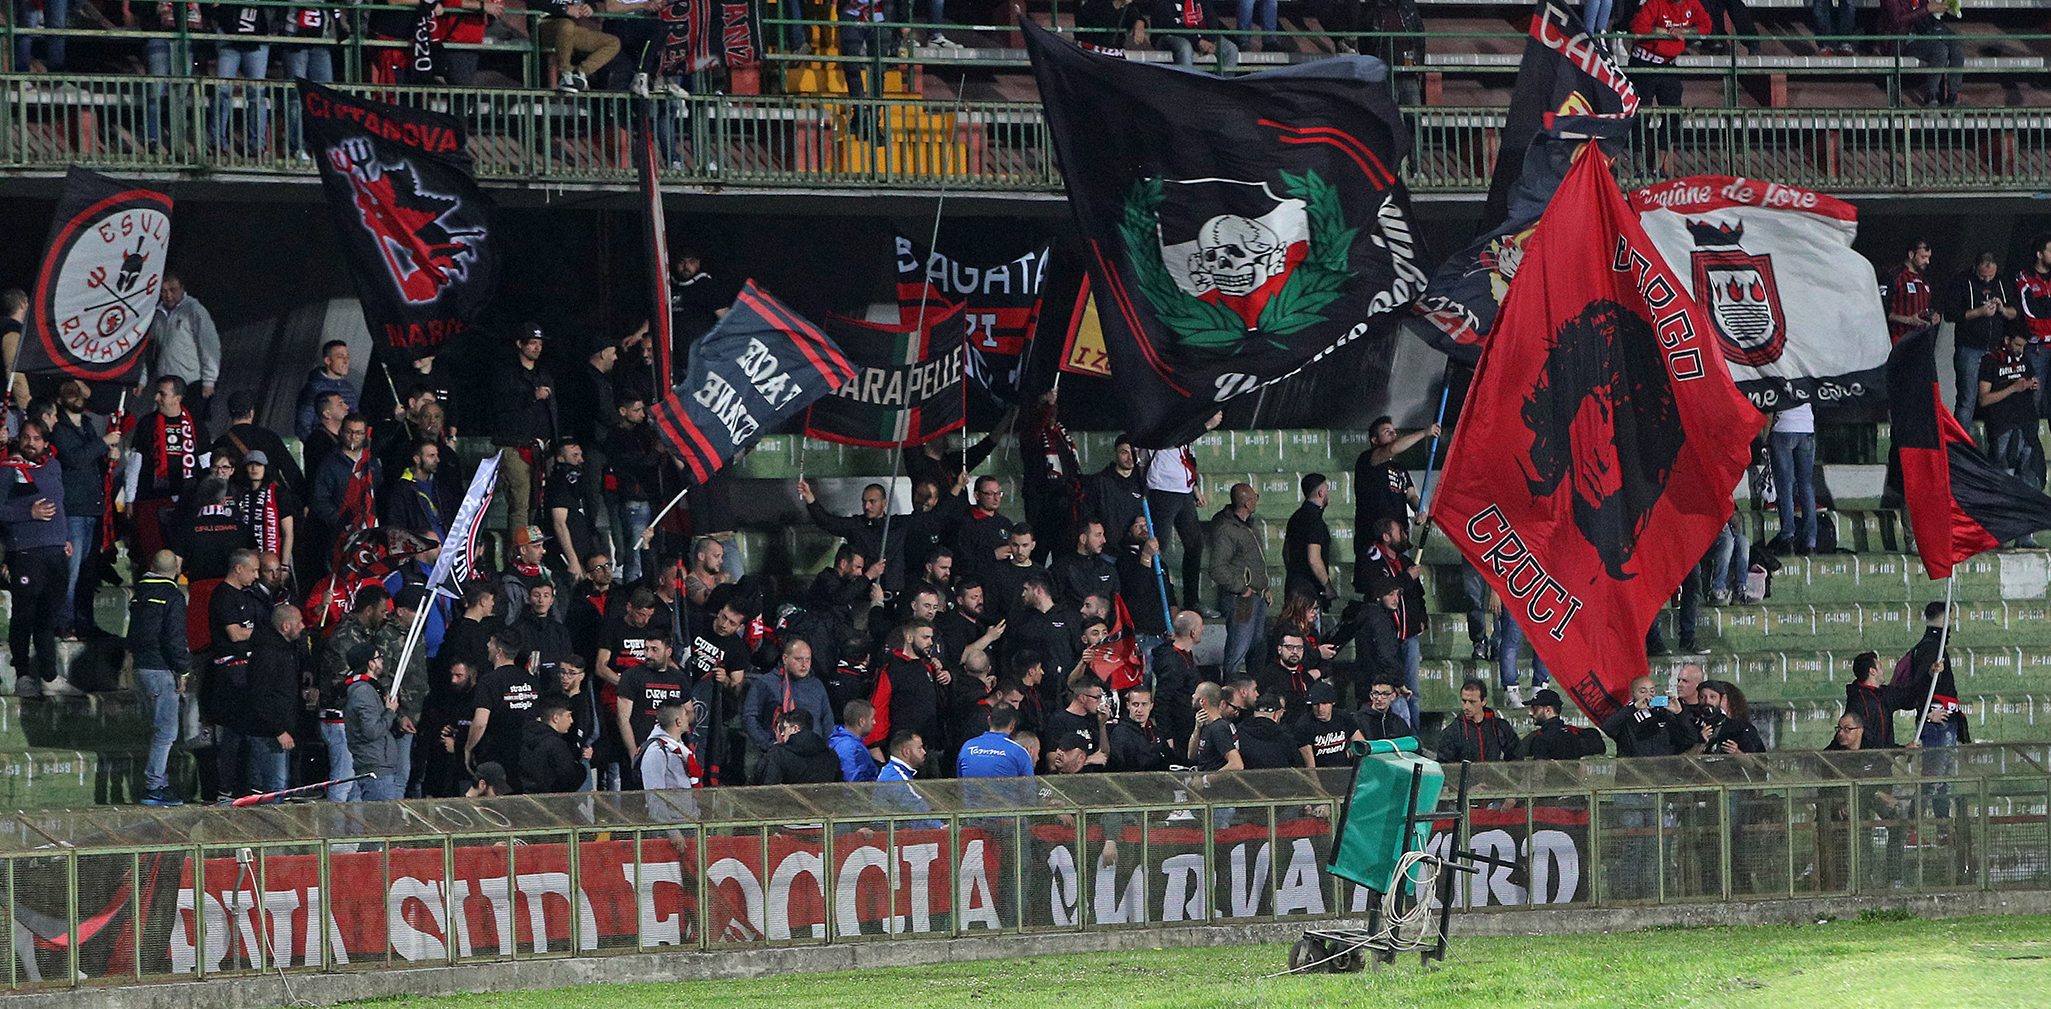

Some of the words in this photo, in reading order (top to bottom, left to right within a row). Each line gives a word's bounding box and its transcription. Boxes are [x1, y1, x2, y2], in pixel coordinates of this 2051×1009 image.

[1632, 47, 1665, 64] SUD
[61, 312, 143, 359] ROMANI
[829, 345, 962, 405] ARAPELLE
[1465, 503, 1583, 642] CROCI
[623, 639, 646, 649] CURV
[509, 682, 532, 693] strada
[967, 745, 1007, 757] Tamma
[389, 871, 598, 962] SUD
[1048, 837, 1326, 927] CURVA
